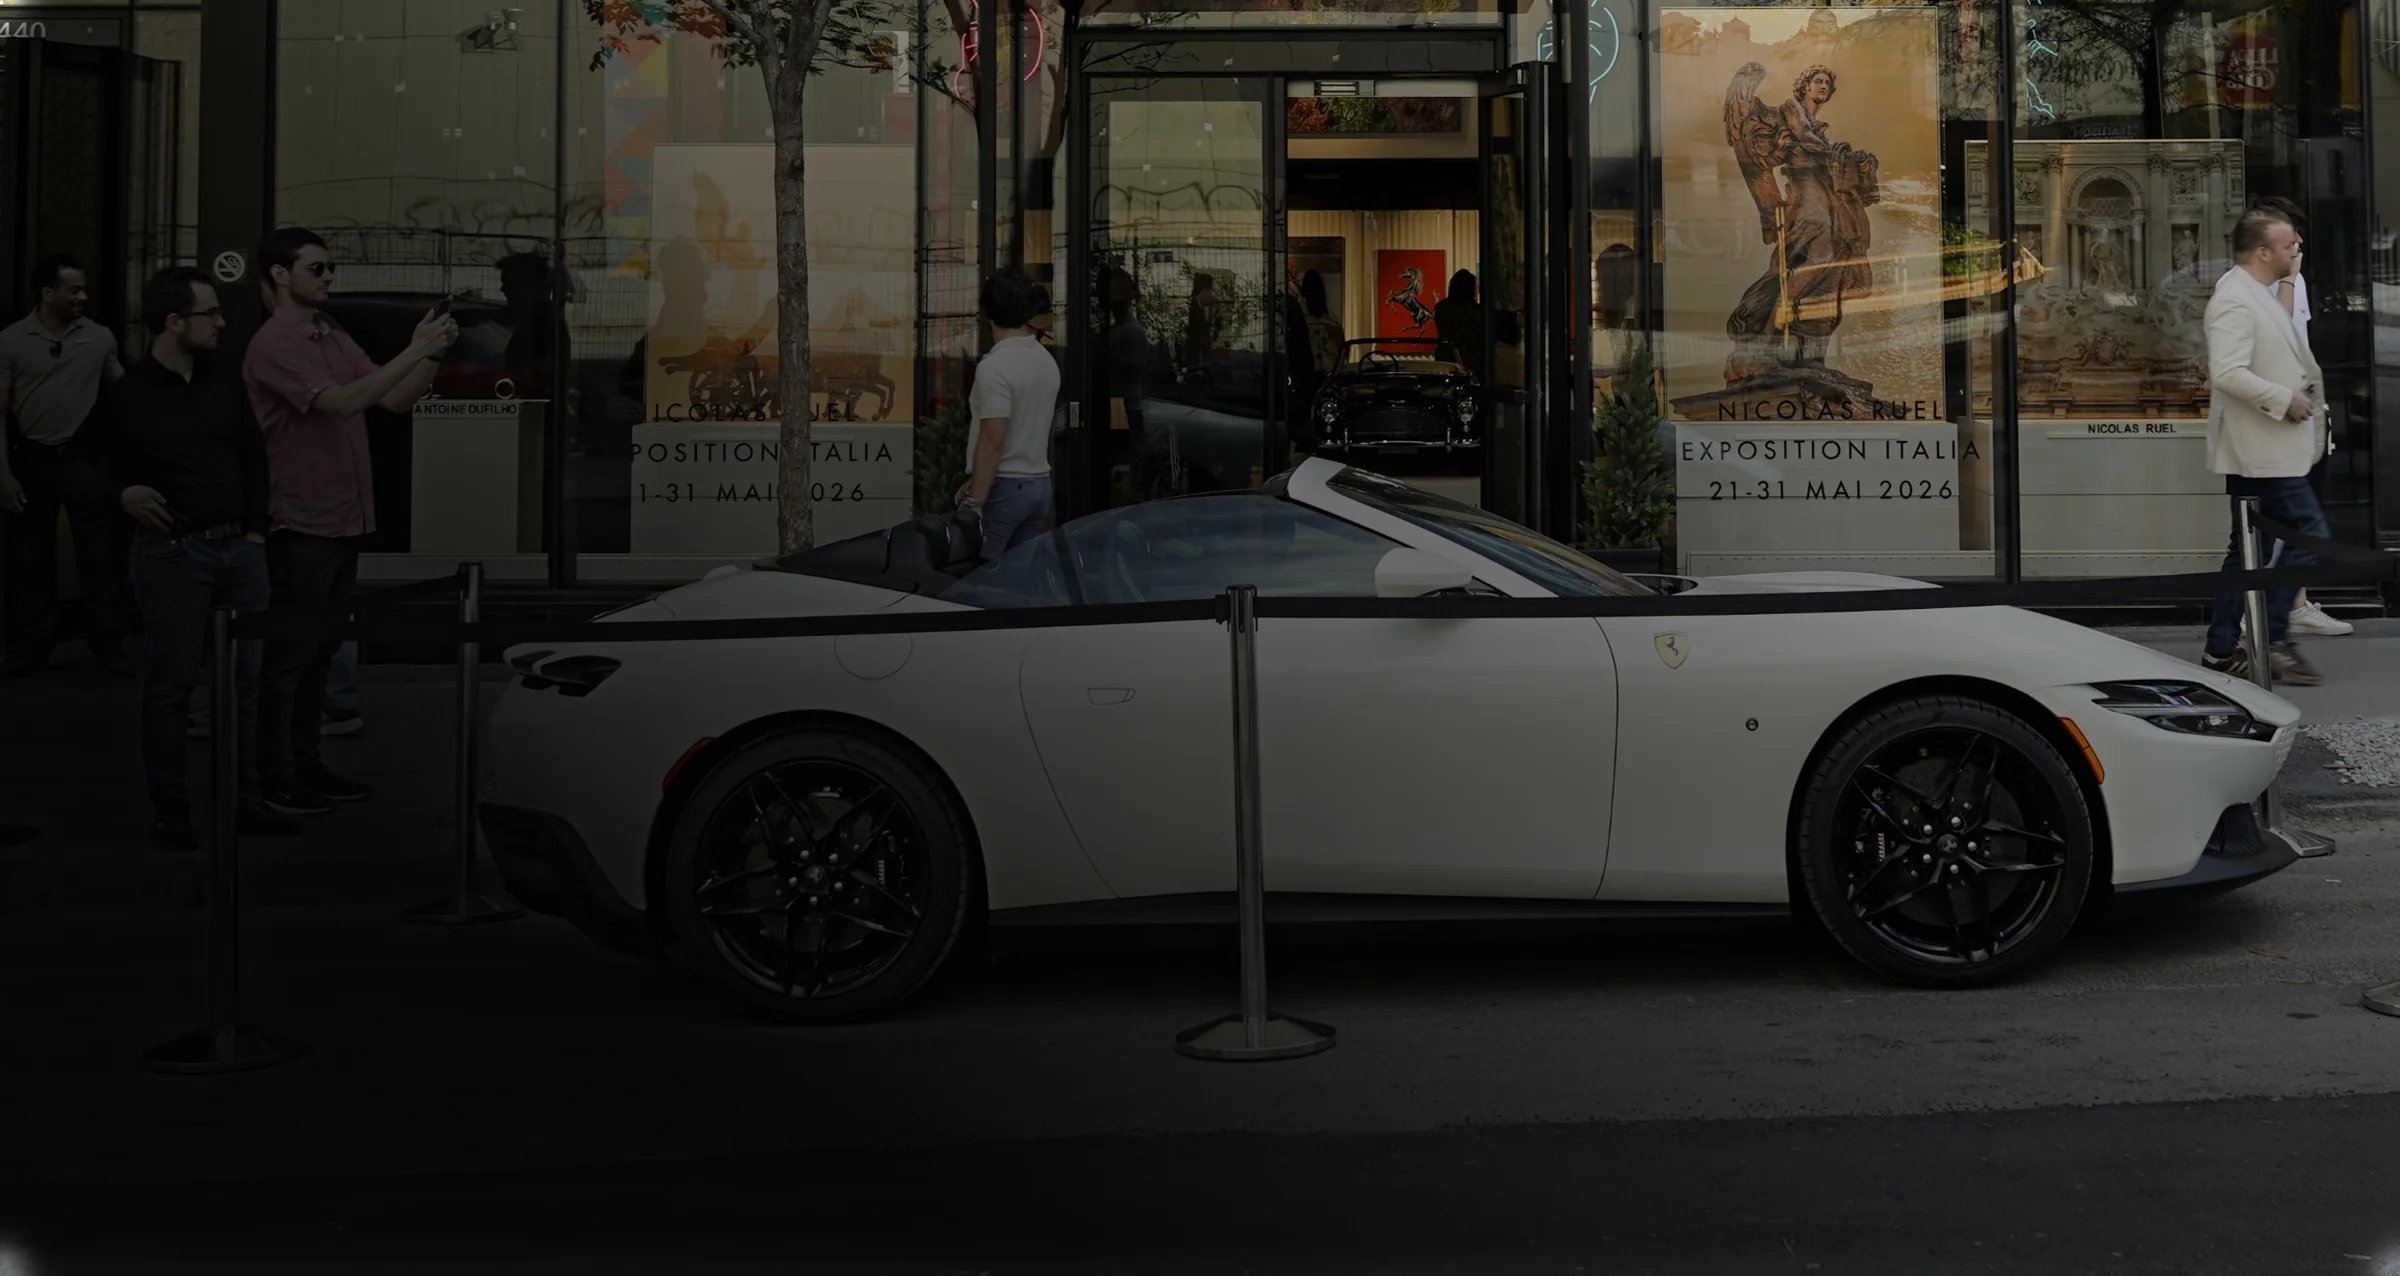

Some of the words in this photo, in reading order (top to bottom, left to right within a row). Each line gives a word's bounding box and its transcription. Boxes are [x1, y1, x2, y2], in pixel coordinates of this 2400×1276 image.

[468, 404, 517, 414] DUFILHO
[655, 403, 767, 422] ICOLAS
[1718, 401, 1853, 420] NICOLAS
[1872, 401, 1942, 419] RUEL
[2088, 423, 2139, 434] NICOLAS
[2146, 423, 2177, 434] RUEL
[631, 443, 778, 462] POSITION
[810, 443, 893, 462] TALIA
[1682, 440, 1866, 460] EXPOSITION
[1886, 440, 1980, 460] ITALIA
[639, 483, 694, 502] 1-31
[716, 482, 772, 502] MAI
[811, 482, 864, 502] 026
[1709, 480, 1784, 501] 21-31
[1805, 480, 1861, 500] MAI
[1880, 480, 1952, 499] 2026
